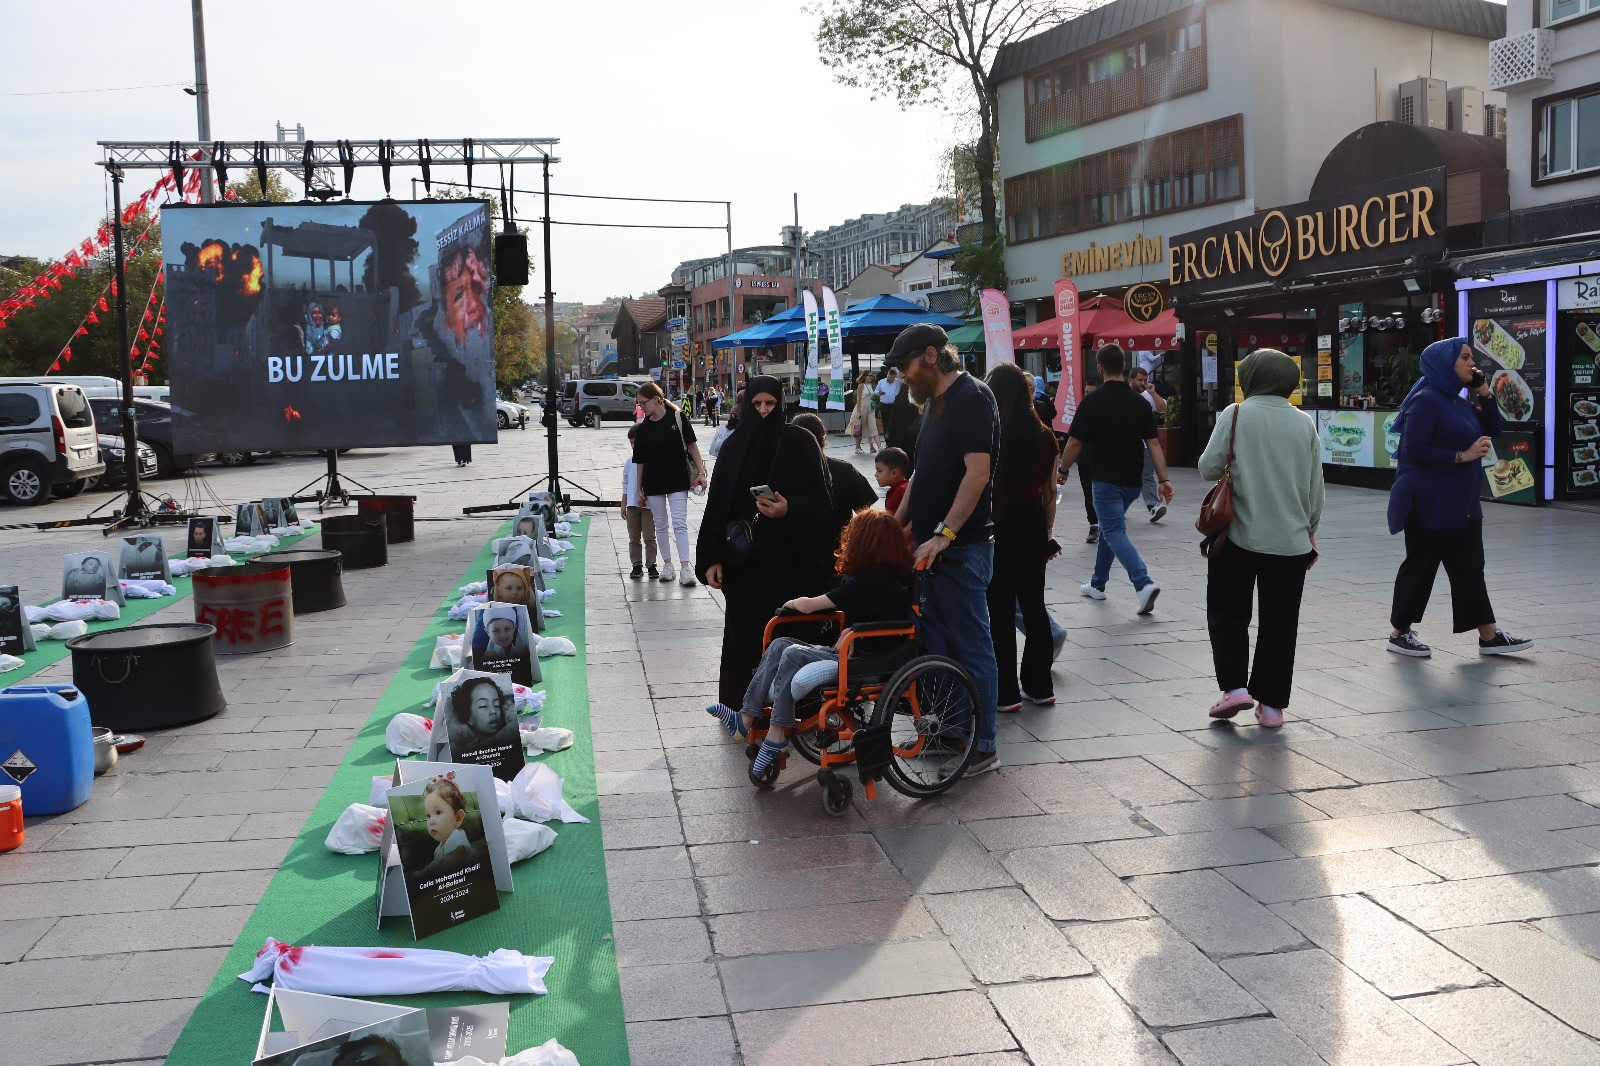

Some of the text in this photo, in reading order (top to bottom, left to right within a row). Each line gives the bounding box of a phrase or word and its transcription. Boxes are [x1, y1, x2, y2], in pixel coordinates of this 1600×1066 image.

[436, 211, 486, 250] SESSİZ KALMA
[1168, 186, 1436, 286] ERCAN BURGER
[1061, 232, 1163, 277] EMİNEVİM
[1574, 280, 1600, 301] Ra
[268, 353, 400, 383] BU ZULME
[196, 599, 285, 646] FREE
[419, 862, 481, 890] Celia Mohamed Khalil
[440, 887, 469, 904] 2024-2024
